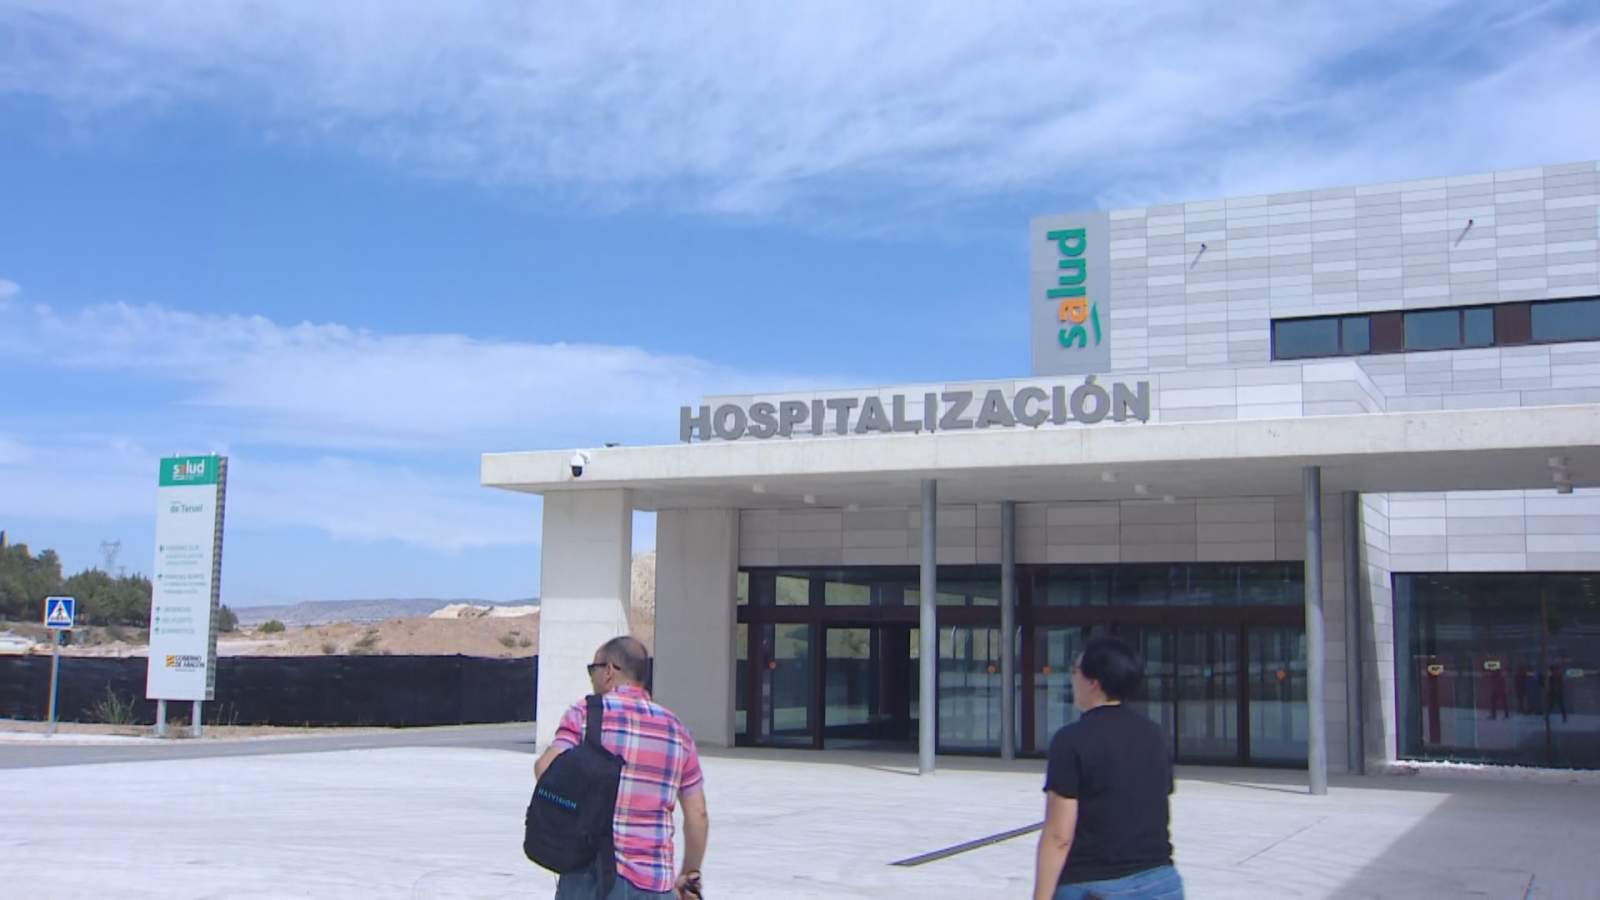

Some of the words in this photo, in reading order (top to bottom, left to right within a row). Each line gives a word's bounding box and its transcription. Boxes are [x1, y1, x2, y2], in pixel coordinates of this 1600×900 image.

[1047, 227, 1087, 349] salud
[680, 375, 1151, 441] HOSPITALIZACIÓN
[173, 459, 205, 474] salud
[181, 504, 203, 513] Teruel
